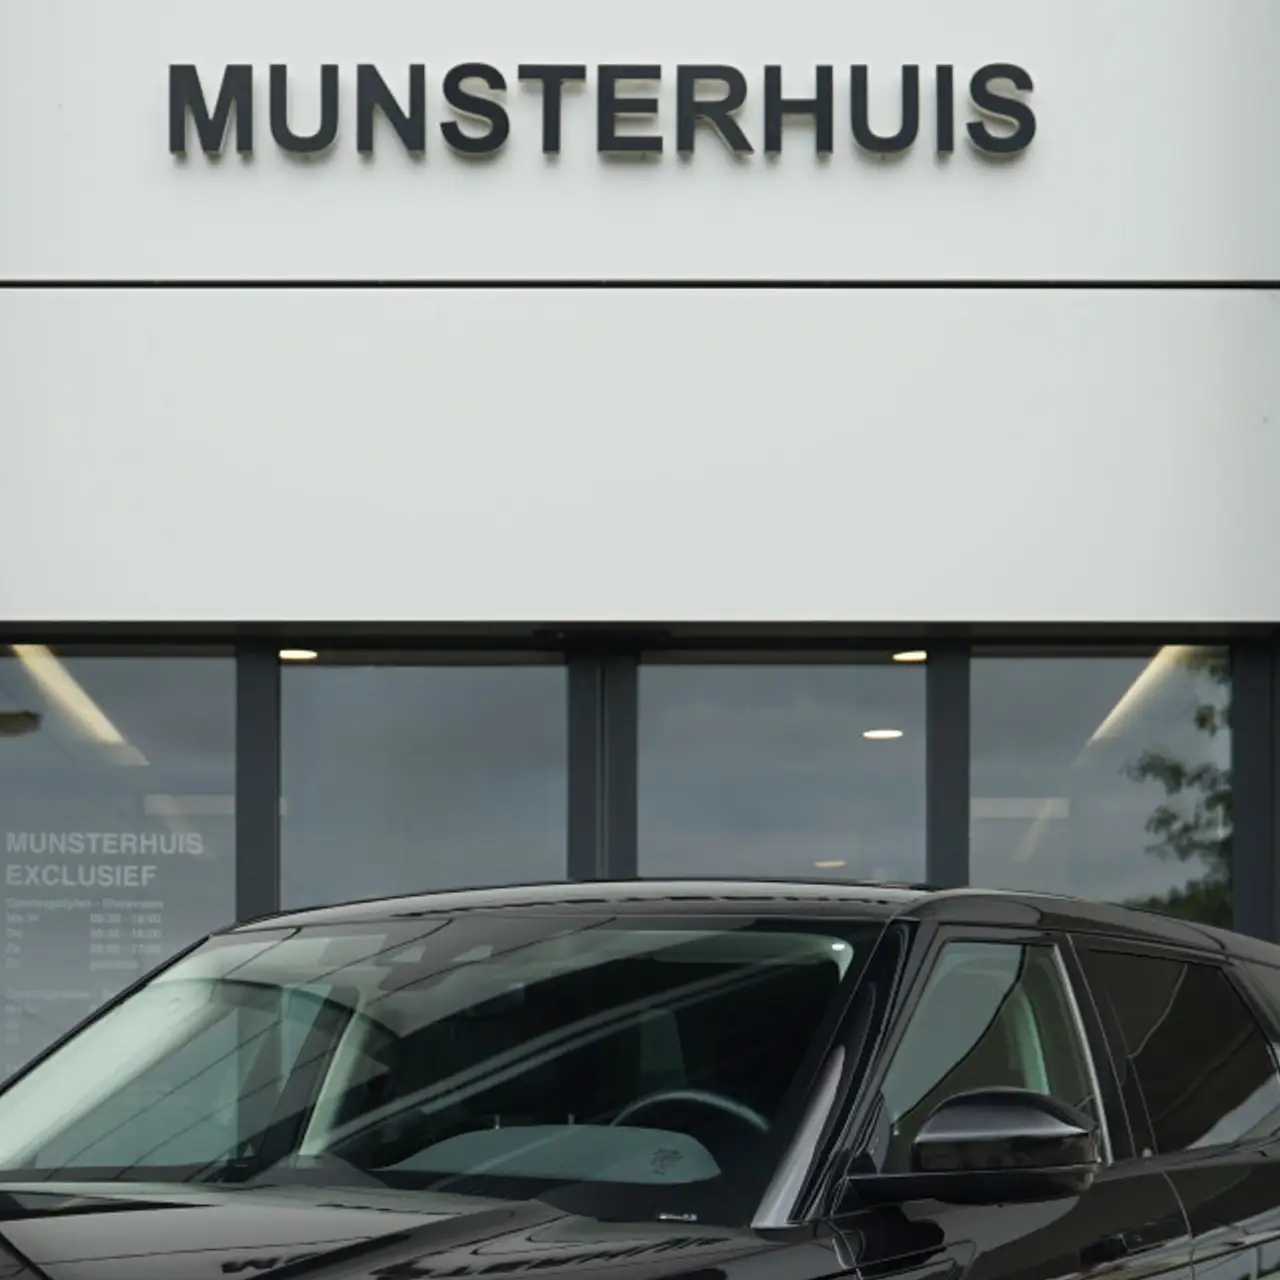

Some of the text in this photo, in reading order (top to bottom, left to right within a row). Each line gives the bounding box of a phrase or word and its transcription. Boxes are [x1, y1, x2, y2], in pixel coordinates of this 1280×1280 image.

[168, 62, 1038, 156] MUNSTERHUIS
[6, 832, 204, 854] MUNSTERHUIS
[6, 863, 158, 887] EXCLUSIEF
